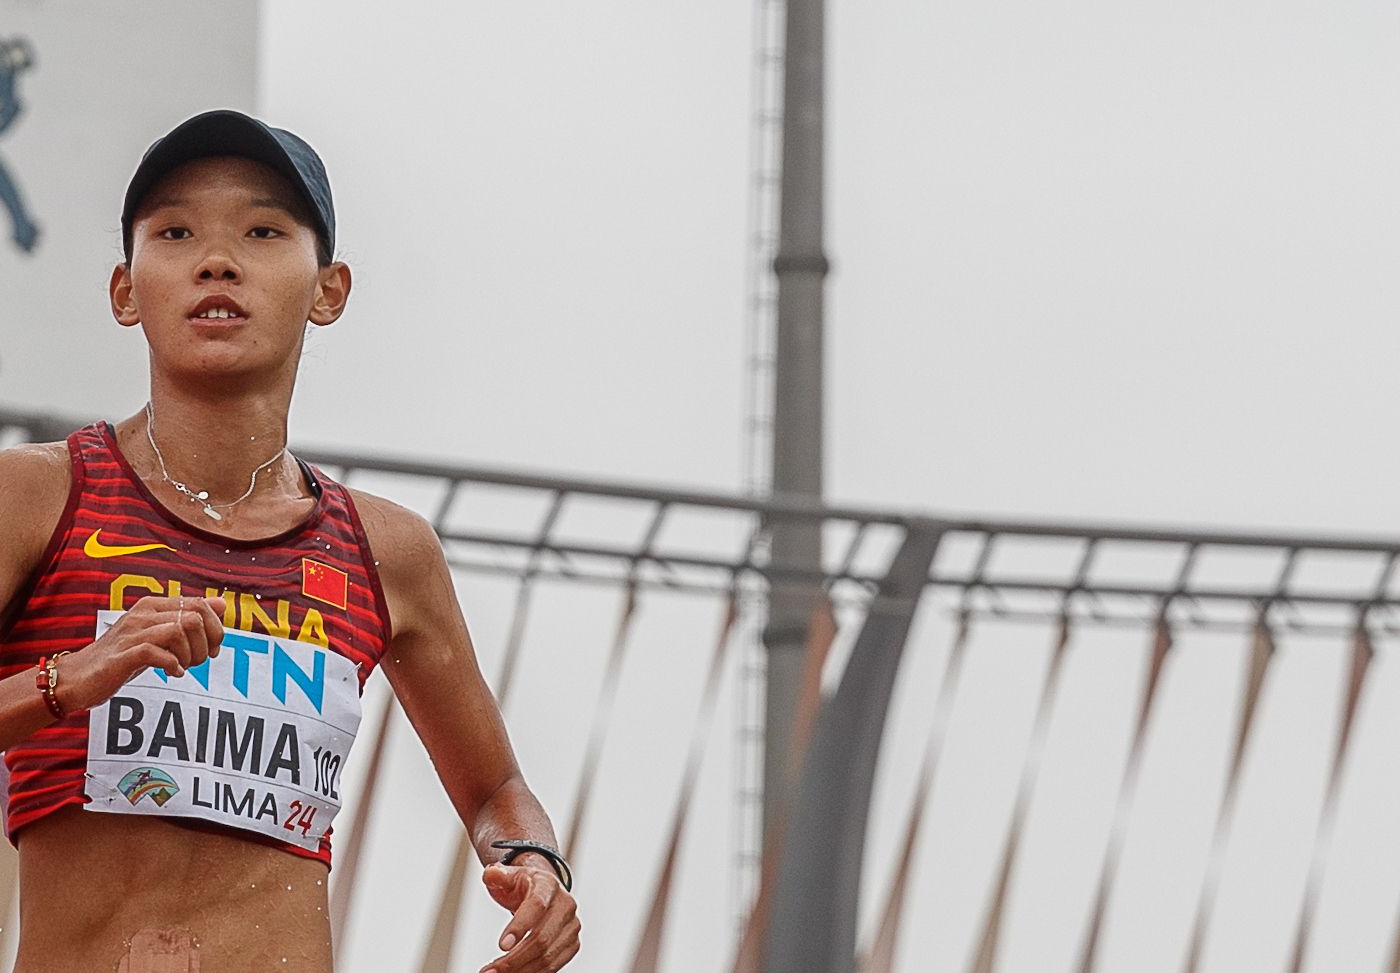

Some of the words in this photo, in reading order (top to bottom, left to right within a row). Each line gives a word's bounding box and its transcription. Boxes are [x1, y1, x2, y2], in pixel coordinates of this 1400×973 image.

[153, 633, 326, 716] TN
[105, 696, 300, 786] BAIMA
[314, 746, 341, 801] 102
[192, 776, 278, 826] LIMA
[283, 800, 318, 837] 24
